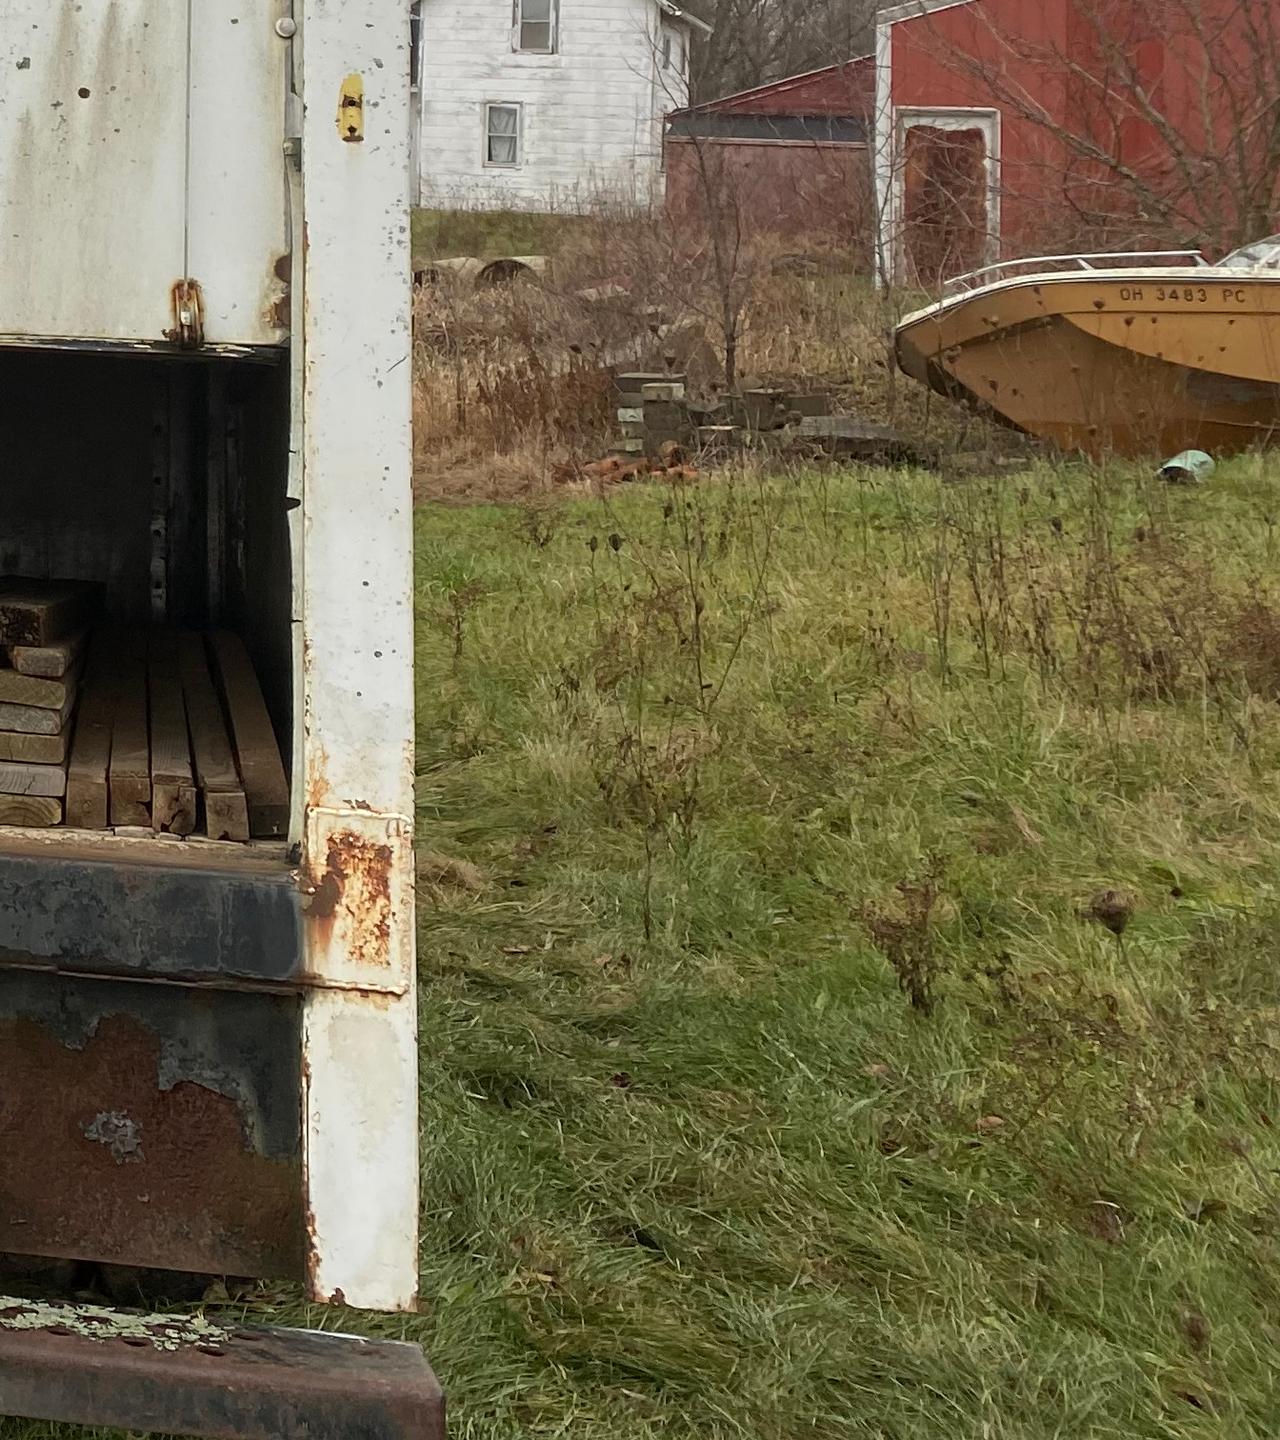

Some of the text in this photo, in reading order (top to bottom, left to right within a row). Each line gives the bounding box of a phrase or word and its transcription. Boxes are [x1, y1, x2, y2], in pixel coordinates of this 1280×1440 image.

[1119, 288, 1246, 303] OH 3483 PC
